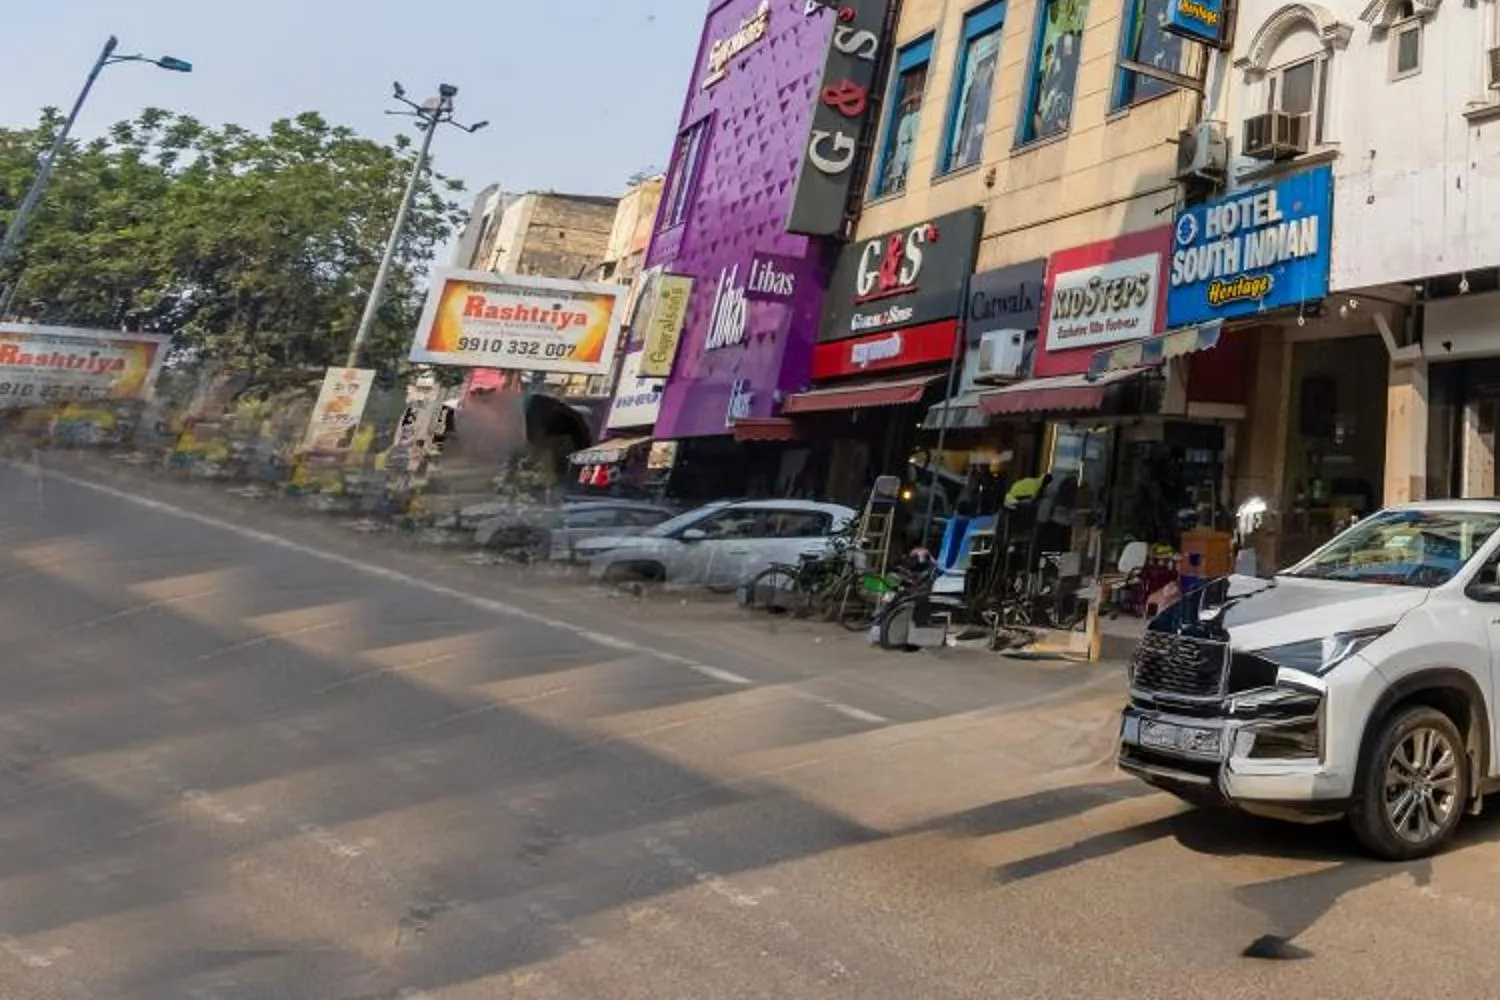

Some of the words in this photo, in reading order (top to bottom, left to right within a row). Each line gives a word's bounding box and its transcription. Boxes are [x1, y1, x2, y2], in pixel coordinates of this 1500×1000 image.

[1206, 189, 1284, 239] HOTEL
[1171, 237, 1241, 287] SOUTH
[1243, 215, 1319, 271] INDIAN
[749, 258, 795, 296] Libas
[1208, 275, 1271, 304] Heritage
[463, 293, 588, 331] Rashtriya
[457, 337, 503, 354] 9910
[506, 341, 540, 356] 332
[545, 342, 577, 359] 007
